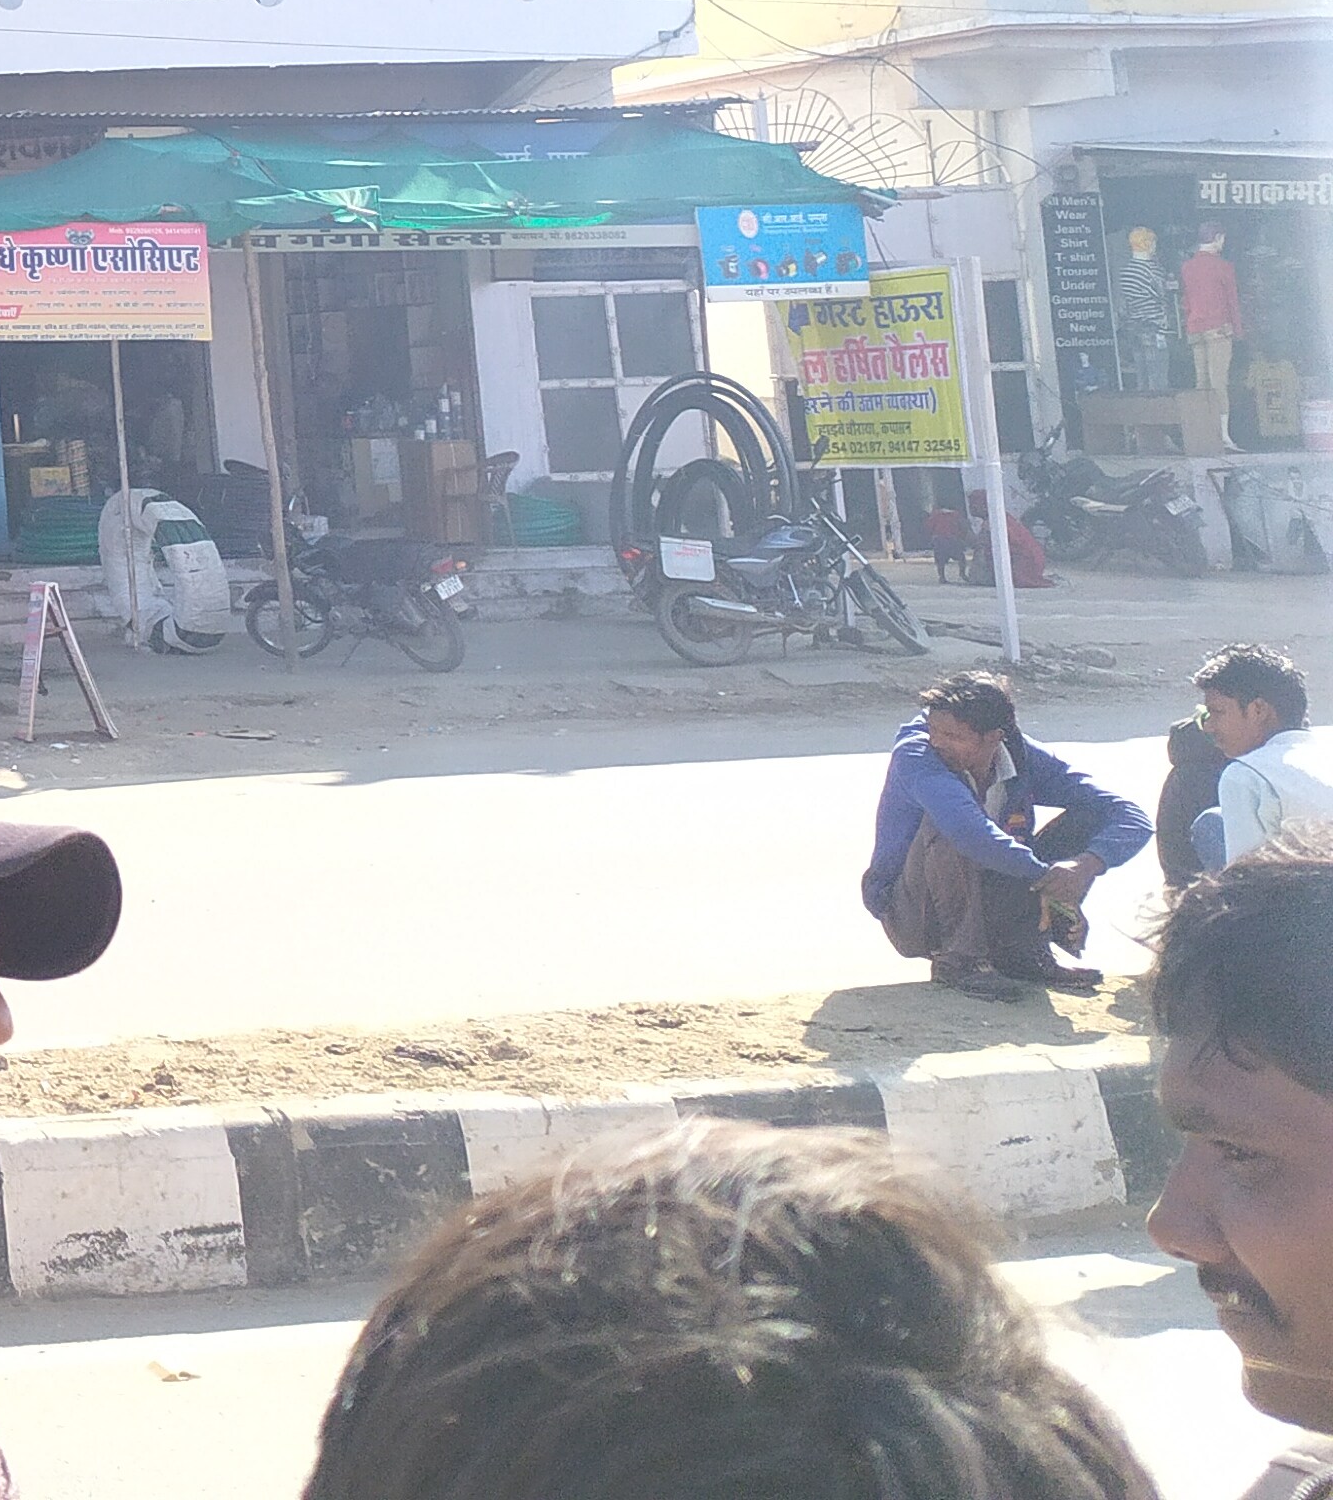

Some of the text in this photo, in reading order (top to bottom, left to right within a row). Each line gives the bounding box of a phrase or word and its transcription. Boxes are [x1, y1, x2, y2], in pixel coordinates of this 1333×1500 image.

[1056, 210, 1087, 219] Wear
[1055, 224, 1091, 234] Jean's
[1060, 239, 1088, 248] Shirt
[20, 244, 88, 282] कृष्णा
[91, 236, 201, 274] एसोसिएट
[1070, 252, 1095, 262] shirt
[1055, 267, 1098, 276] Trouser
[1061, 281, 1096, 290] Under
[1052, 295, 1108, 305] Garments
[870, 292, 944, 328] हाऊस
[1058, 309, 1105, 321] Goggles
[1070, 323, 1096, 332] New
[1056, 337, 1114, 347] Collection
[831, 332, 950, 383] हर्षित पैलेस
[835, 391, 855, 412] की
